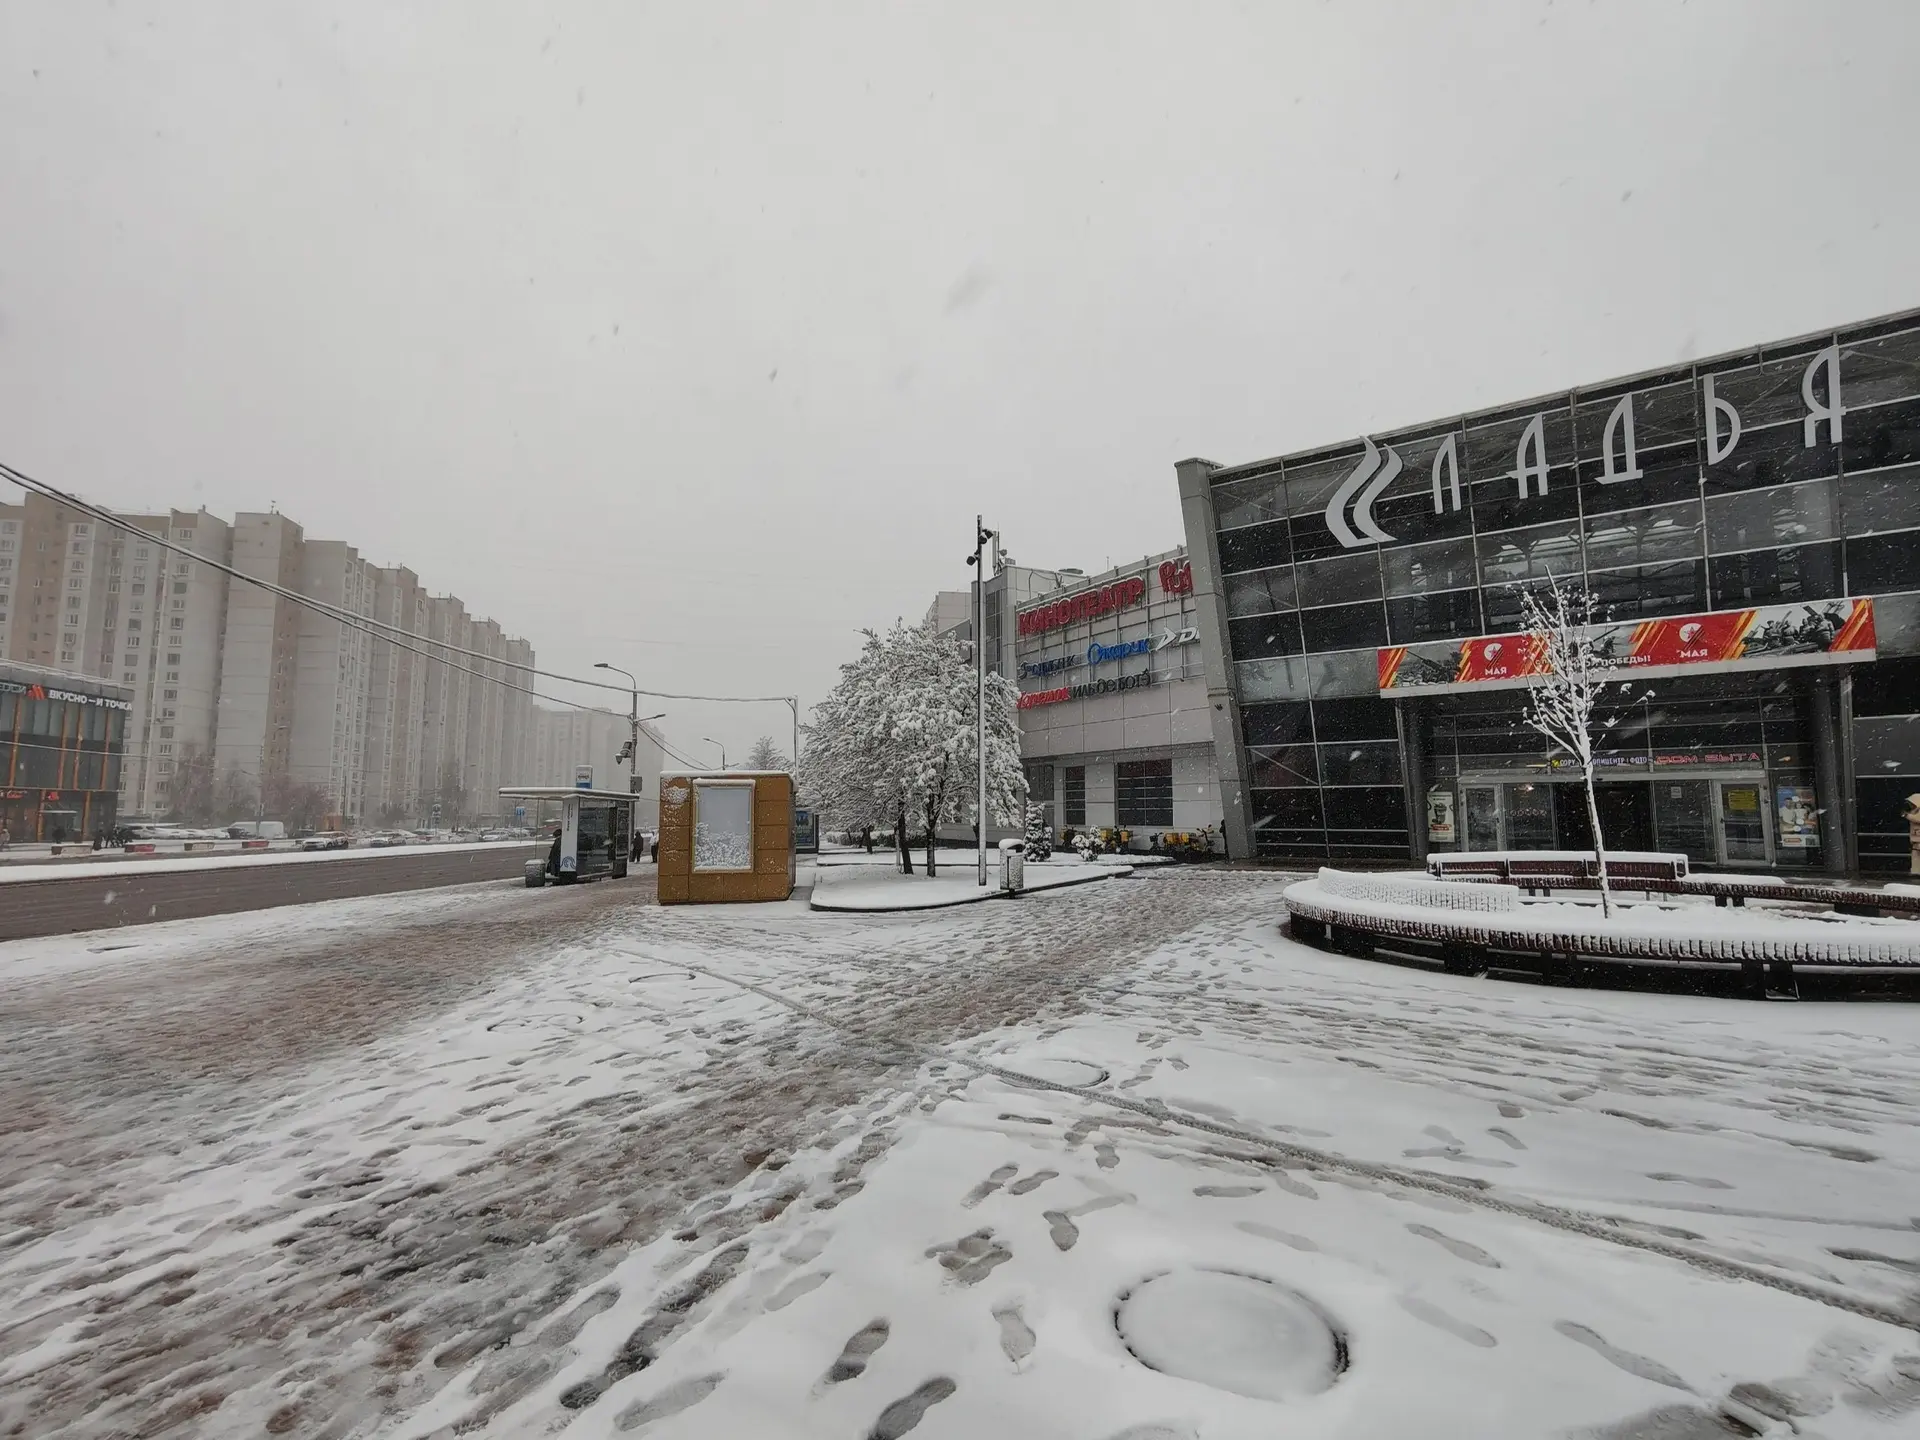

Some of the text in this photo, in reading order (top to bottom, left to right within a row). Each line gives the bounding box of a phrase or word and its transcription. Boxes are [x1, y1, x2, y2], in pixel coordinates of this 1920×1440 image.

[1431, 344, 1847, 515] ЛАДЬЯ
[1019, 575, 1145, 636] КИНОТЕАТР
[1680, 649, 1708, 658] МАЯ
[1484, 666, 1507, 675] МАЯ
[48, 689, 88, 705] ВКУСНО
[96, 697, 104, 707] И
[104, 699, 133, 711] ТОЧКА
[1559, 758, 1576, 767] COPY
[1592, 757, 1625, 766] ОПИЦЕНТР
[1703, 752, 1761, 764] БЫТА
